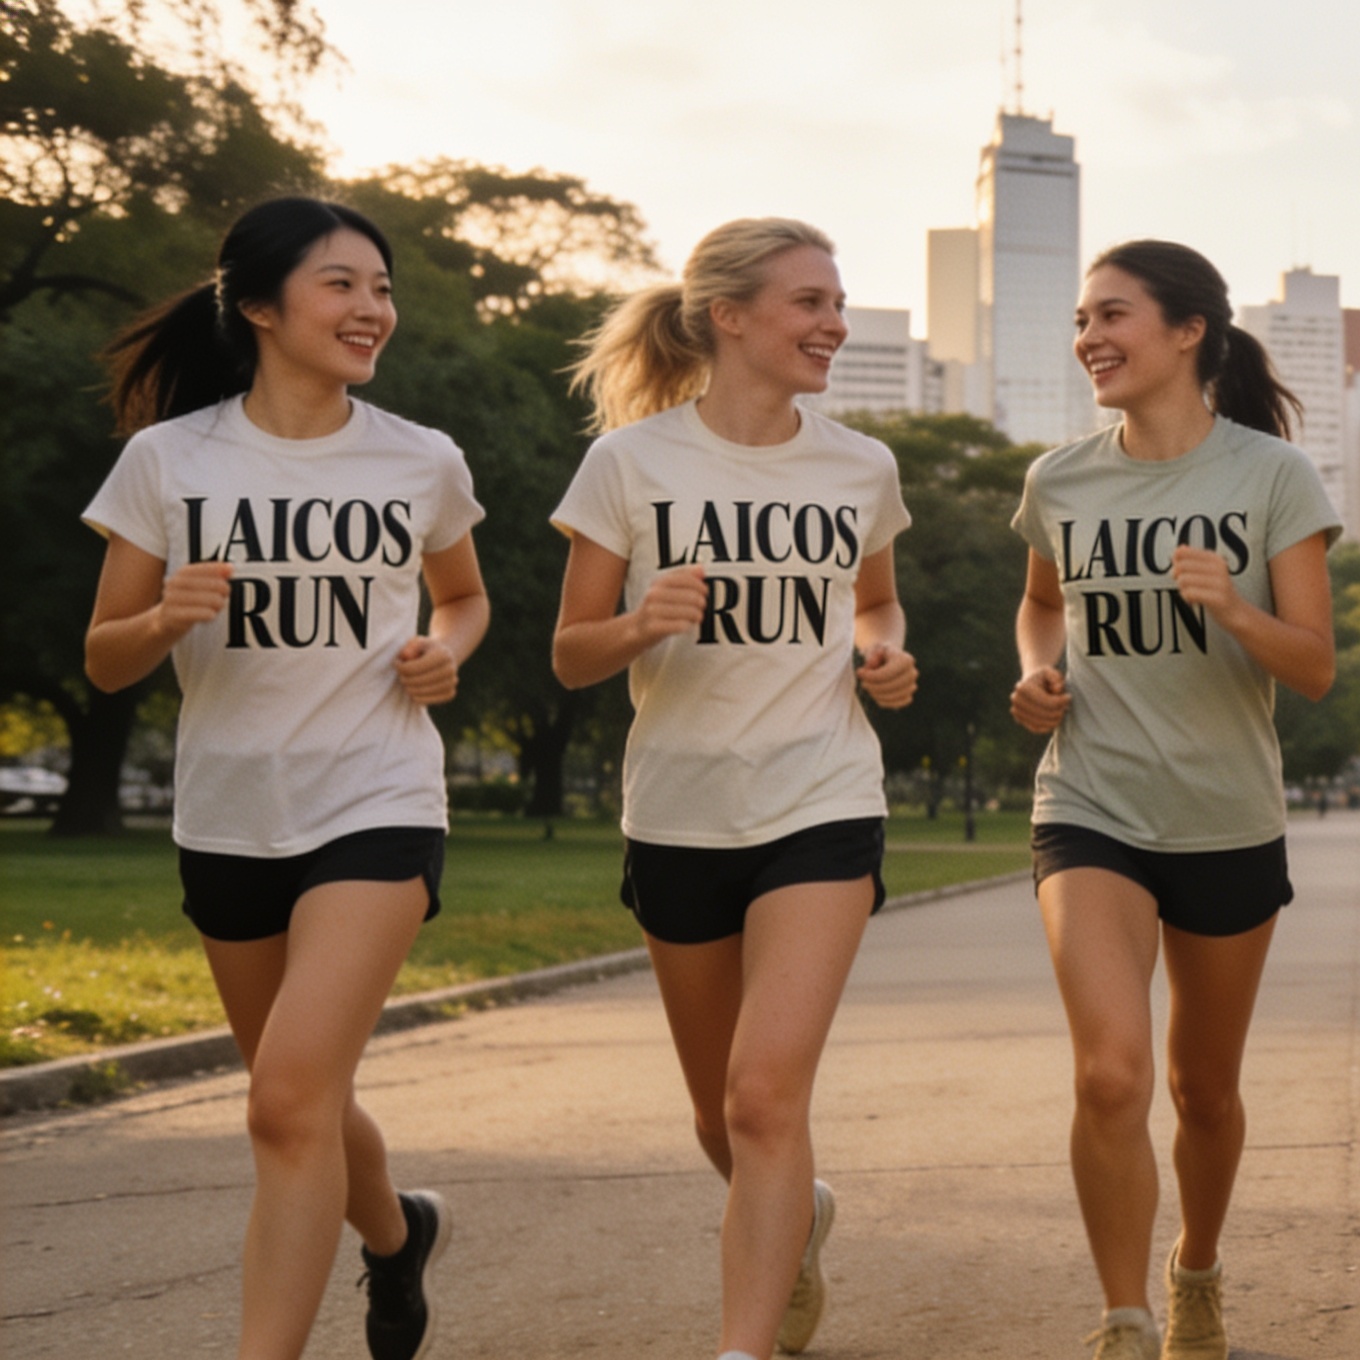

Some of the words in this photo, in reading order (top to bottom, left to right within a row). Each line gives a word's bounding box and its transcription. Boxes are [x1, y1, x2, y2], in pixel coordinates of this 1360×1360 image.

[182, 497, 412, 567] LAICOS
[651, 501, 858, 570] LAICOS
[1058, 511, 1249, 583] LAICOS
[225, 576, 375, 649] RUN
[696, 576, 831, 647] RUN
[1082, 588, 1208, 657] RUN
